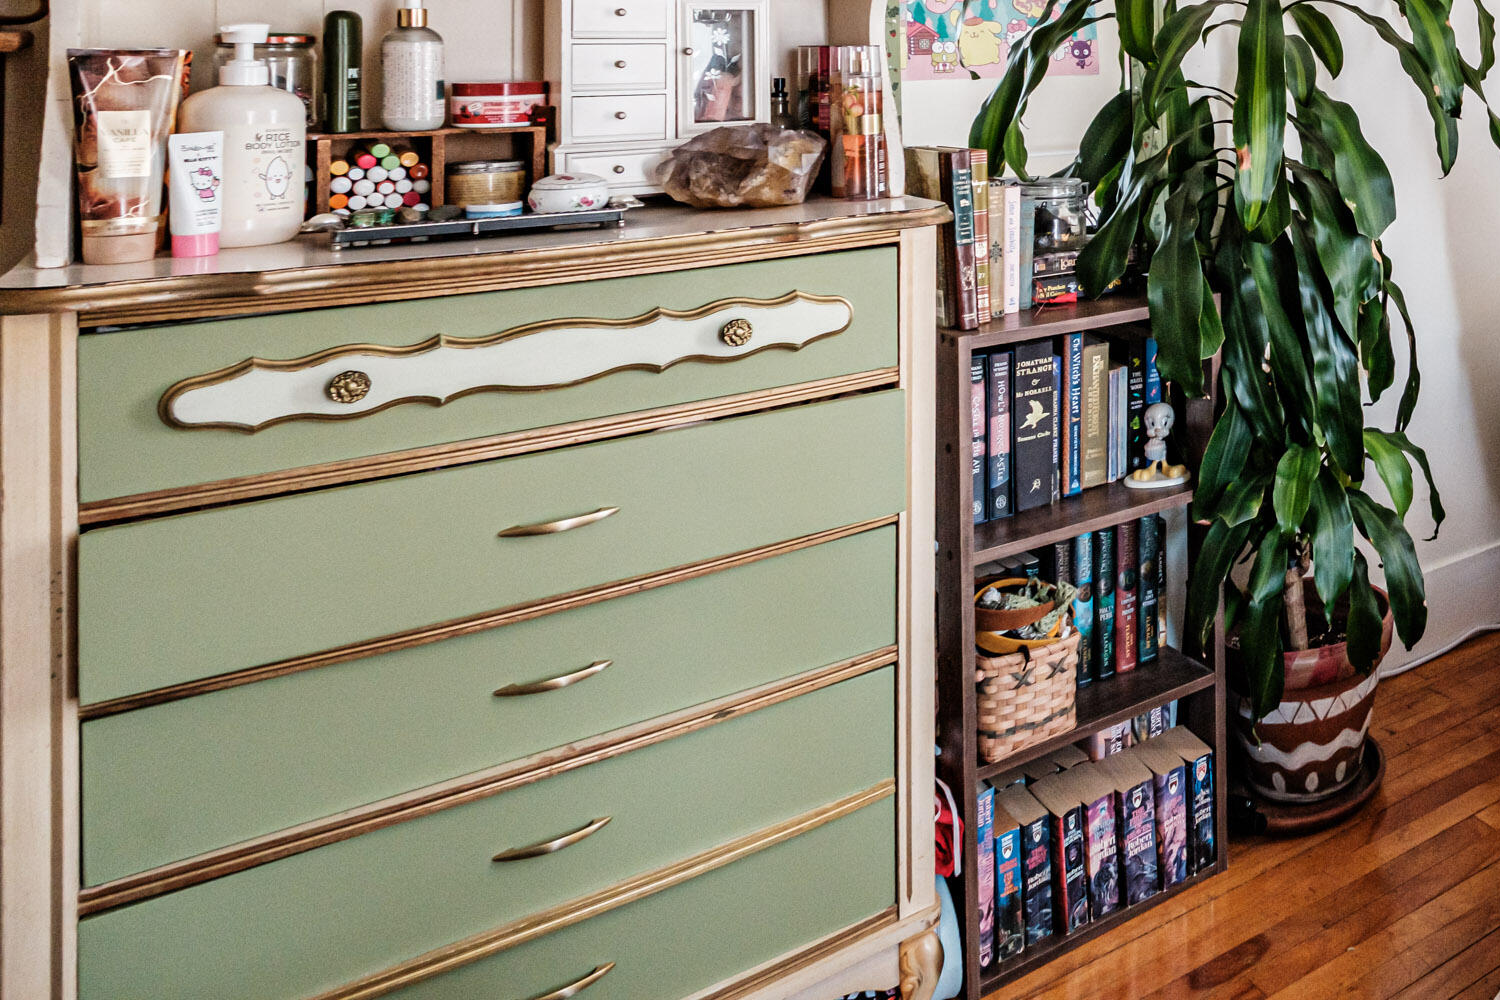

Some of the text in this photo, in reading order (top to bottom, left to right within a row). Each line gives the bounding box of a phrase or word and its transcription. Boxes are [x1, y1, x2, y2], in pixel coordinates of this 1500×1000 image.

[265, 133, 290, 141] RICE
[1016, 357, 1053, 370] JONATHAN
[1016, 366, 1053, 377] STRANGE
[1072, 337, 1081, 413] The Witch's Heart
[1024, 386, 1053, 396] NORRELL
[972, 395, 980, 426] CASTLE
[972, 439, 980, 457] THE
[972, 459, 980, 475] AIR
[996, 450, 1006, 481] CASTLE
[977, 798, 985, 827] Jordan
[984, 795, 992, 825] Robert
